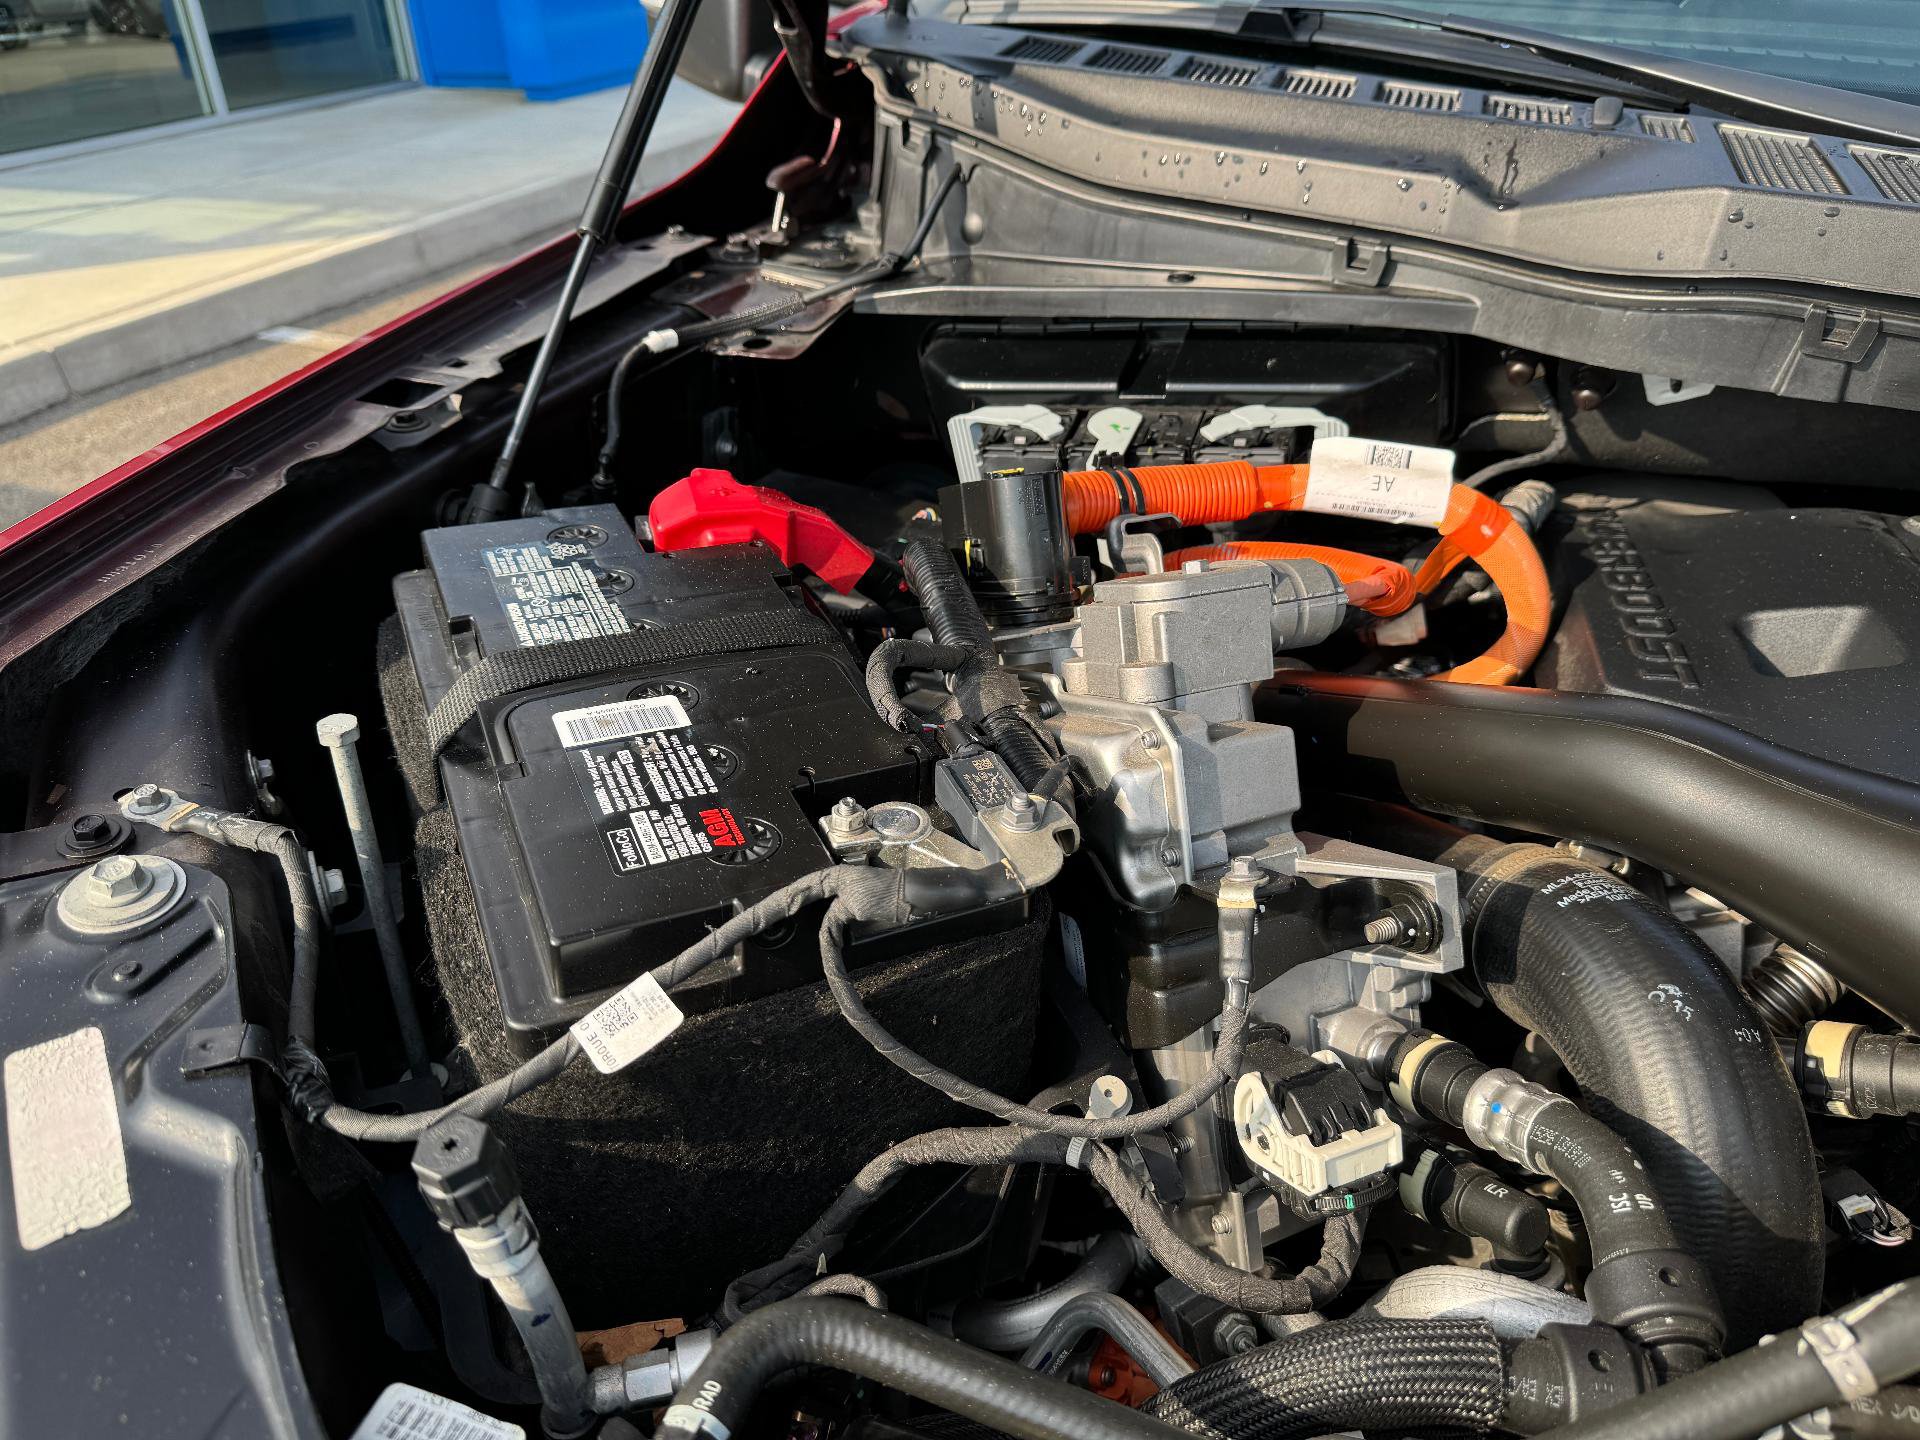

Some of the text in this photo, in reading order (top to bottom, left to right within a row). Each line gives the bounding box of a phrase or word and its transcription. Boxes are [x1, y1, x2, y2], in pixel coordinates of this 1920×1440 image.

[1368, 473, 1395, 494] AE
[698, 807, 737, 850] AGM
[720, 806, 746, 845] TECHNOLOGY
[613, 829, 640, 867] FoMoCo
[585, 1030, 620, 1071] TORQUE
[1483, 1182, 1509, 1199] ILR
[693, 1378, 723, 1412] RAD
